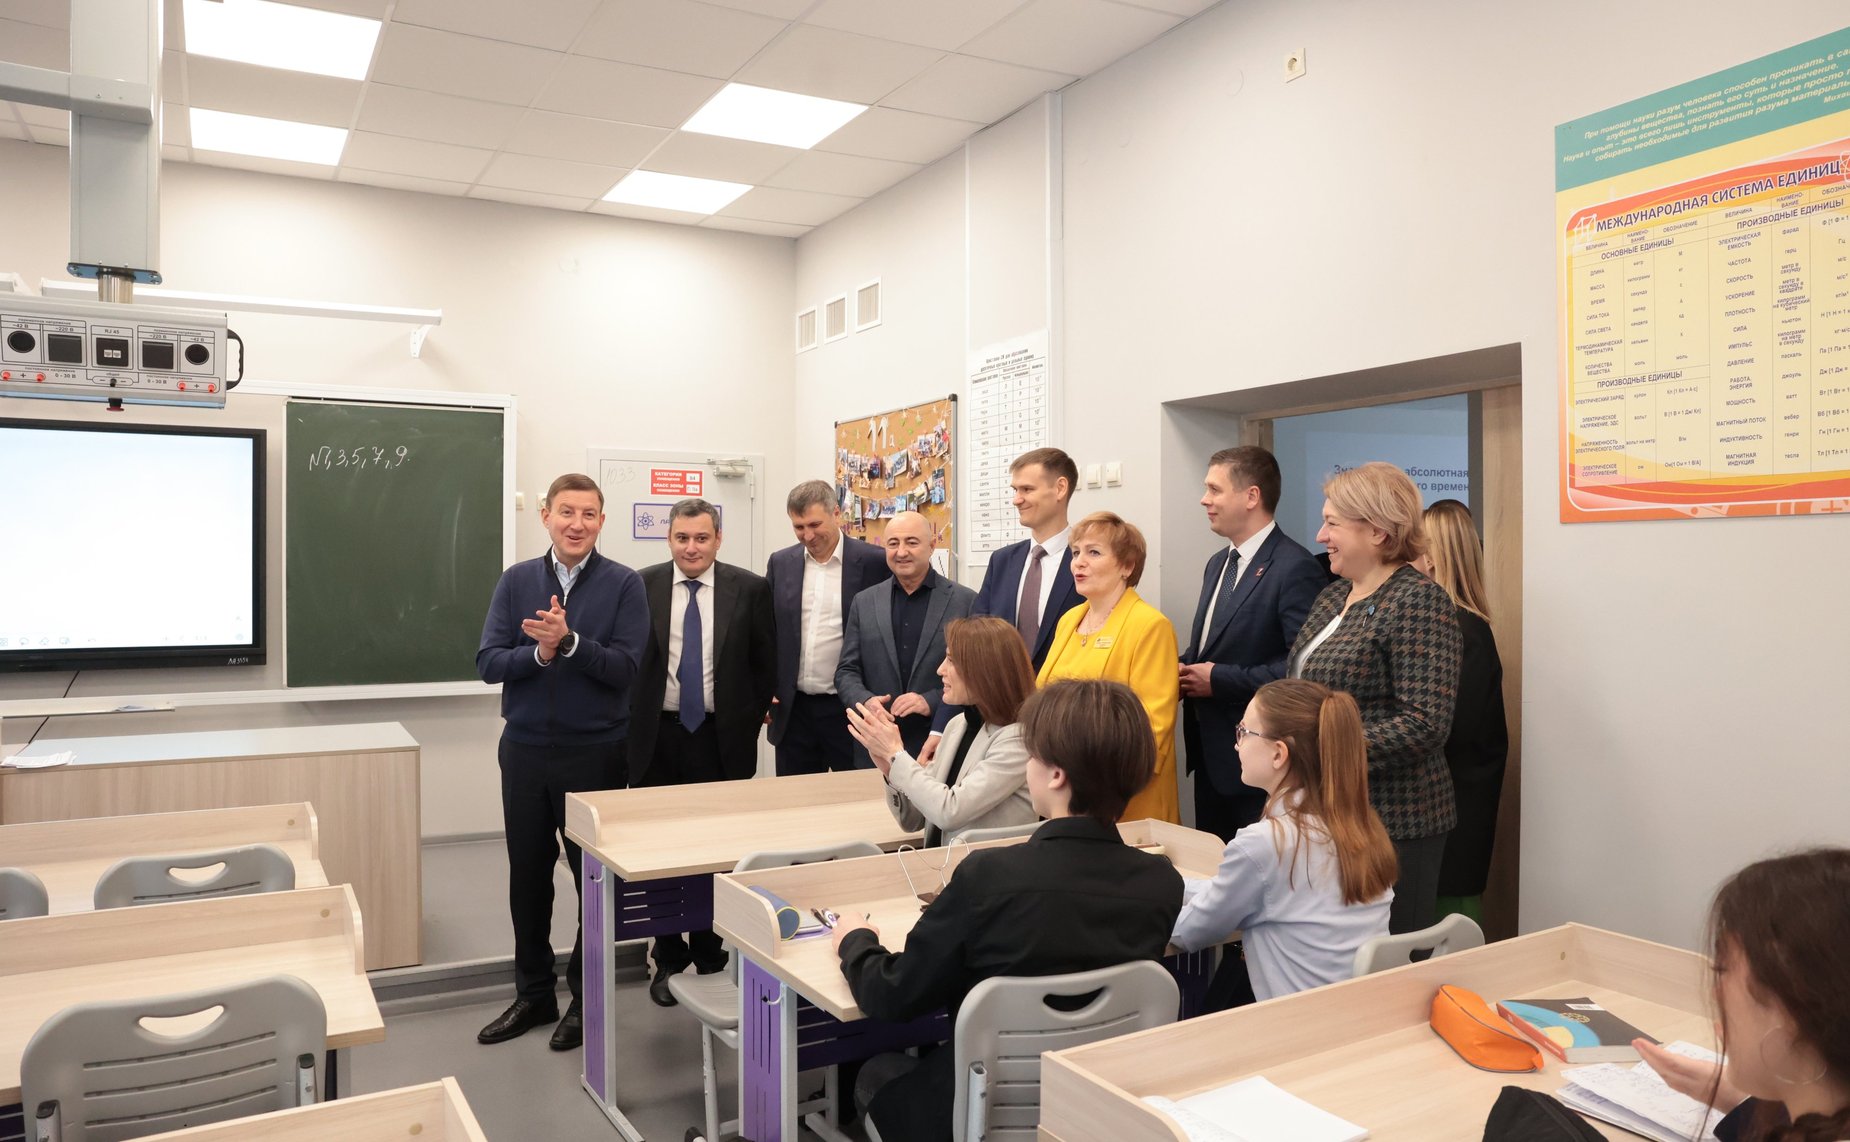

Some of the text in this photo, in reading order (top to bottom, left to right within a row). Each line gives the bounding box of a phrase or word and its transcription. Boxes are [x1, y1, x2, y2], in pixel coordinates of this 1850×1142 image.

[1584, 130, 1599, 140] При
[1600, 120, 1632, 135] помощи
[1632, 112, 1655, 125] науки
[1656, 104, 1681, 119] разум
[1683, 90, 1722, 108] человека
[1724, 76, 1767, 95] способен
[1769, 58, 1825, 80] проникать
[1606, 124, 1640, 141] глубины
[1686, 100, 1724, 117] познать
[1744, 86, 1768, 98] суть
[1770, 82, 1776, 90] и
[1778, 63, 1839, 86] назначение.
[1563, 152, 1585, 164] Наука
[1592, 142, 1614, 155] опыт
[1621, 136, 1637, 146] это
[1638, 128, 1661, 141] всего
[1662, 122, 1686, 133] лишь
[1756, 85, 1802, 104] которые
[1804, 72, 1844, 89] просто
[1595, 146, 1633, 162] собирать
[1634, 129, 1690, 151] необходимые
[1692, 124, 1708, 134] для
[1709, 109, 1754, 130] развития
[1756, 98, 1789, 115] разума
[1596, 160, 1840, 232] МЕЖДУНАРОДНАЯ СИСТЕМА ЕДИНИЦ
[1781, 200, 1800, 208] ВАНИЕ
[1724, 207, 1753, 218] ВЕЛИЧИНА
[1736, 198, 1844, 230] ПРОИЗВОДНЫЕ ЕДИНИЦЫ
[1662, 220, 1698, 233] ОБОЗНАЧЕНИЕ
[1718, 232, 1761, 246] ЭЛЕКТРИЧЕСКАЯ
[1586, 242, 1608, 251] ВЕЛИЧИНА
[1601, 238, 1674, 260] ОСНОВНЫЕ ЕДИНИЦЫ
[1727, 240, 1752, 250] ЕМКОСТЬ
[1728, 258, 1752, 267] ЧАСТОТА
[1726, 274, 1754, 284] СКОРОСТЬ
[1725, 290, 1755, 300] УСКОРЕНИЕ
[1724, 308, 1756, 318] ПЛОТНОСТЬ
[1728, 342, 1753, 350] ИМПУЛЬС
[1727, 358, 1754, 367] ДАВЛЕНИЕ
[1597, 371, 1683, 389] ПРОИЗВОДНЫЕ ЕДИНИЦЫ
[1726, 398, 1756, 406] МОЩНОСТЬ
[1716, 418, 1748, 427] МАГНИТНЫЙ
[1720, 434, 1762, 443] ИНДУКТИВНОСТЬ
[1726, 452, 1757, 460] МАГНИТНАЯ
[1728, 459, 1755, 467] ИНДУКЦИЯ
[1404, 466, 1468, 478] абсолютная
